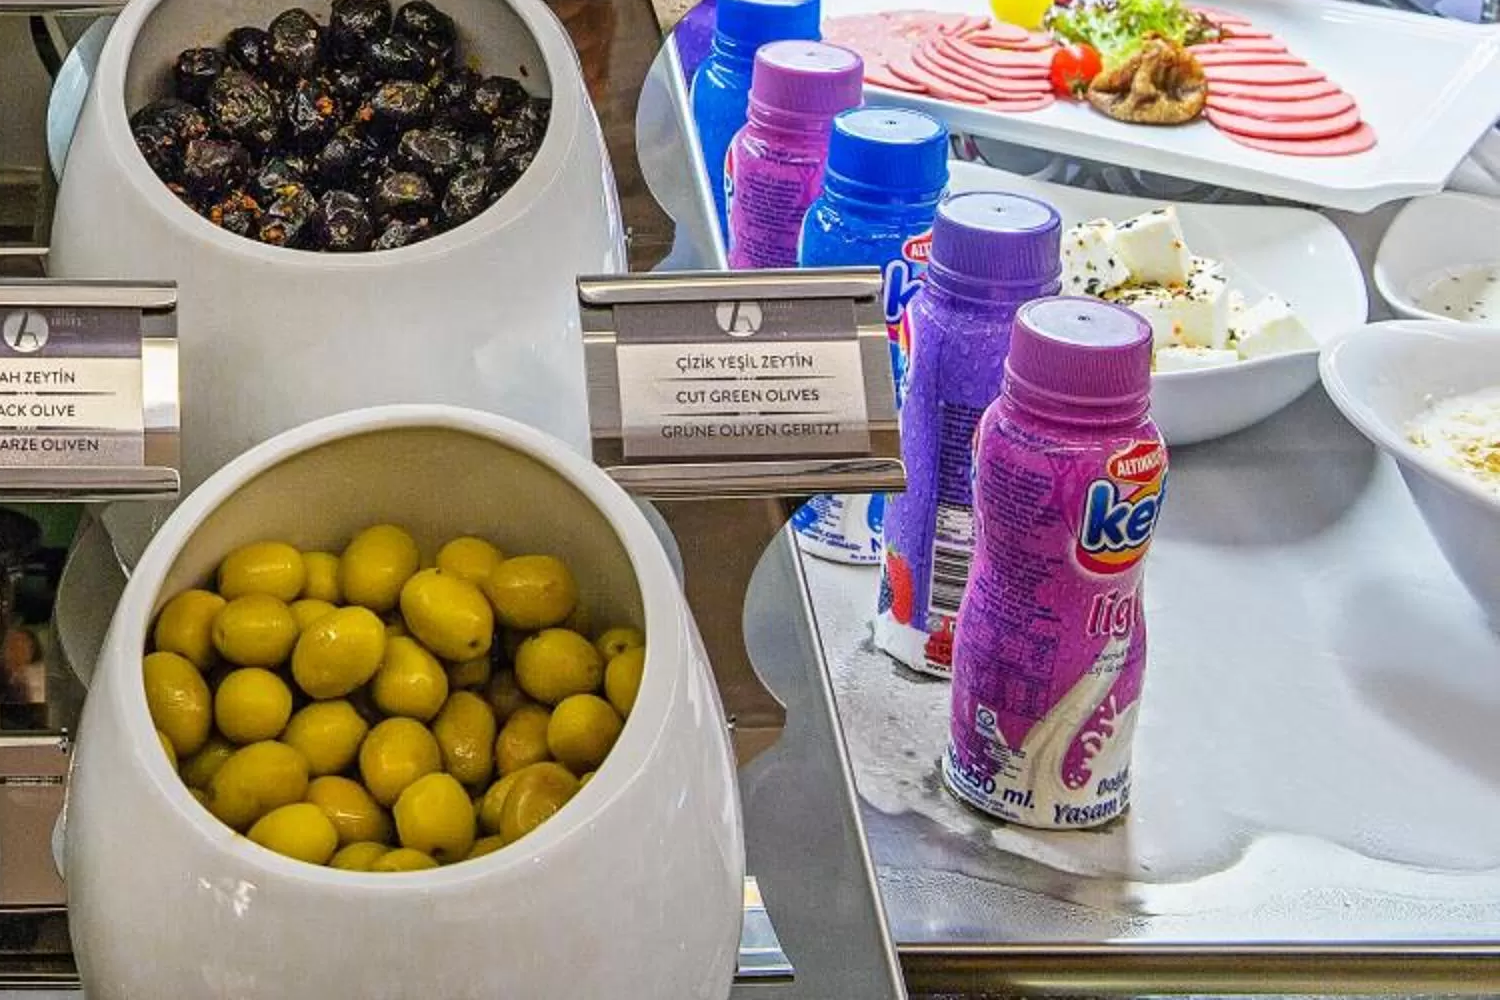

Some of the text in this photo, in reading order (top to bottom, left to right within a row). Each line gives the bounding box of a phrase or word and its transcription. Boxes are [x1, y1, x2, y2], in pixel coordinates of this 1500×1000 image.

[676, 352, 813, 374] ÇİZİK YEŞİL ZEYTİN
[25, 367, 75, 384] ZEYTİN
[676, 389, 820, 404] CUT GREEN OLIVES
[30, 404, 75, 418] OLIVE
[661, 423, 839, 439] GRÜNE OLIVEN GERITZT
[41, 438, 100, 452] OLIVEN
[1003, 788, 1035, 809] ml.
